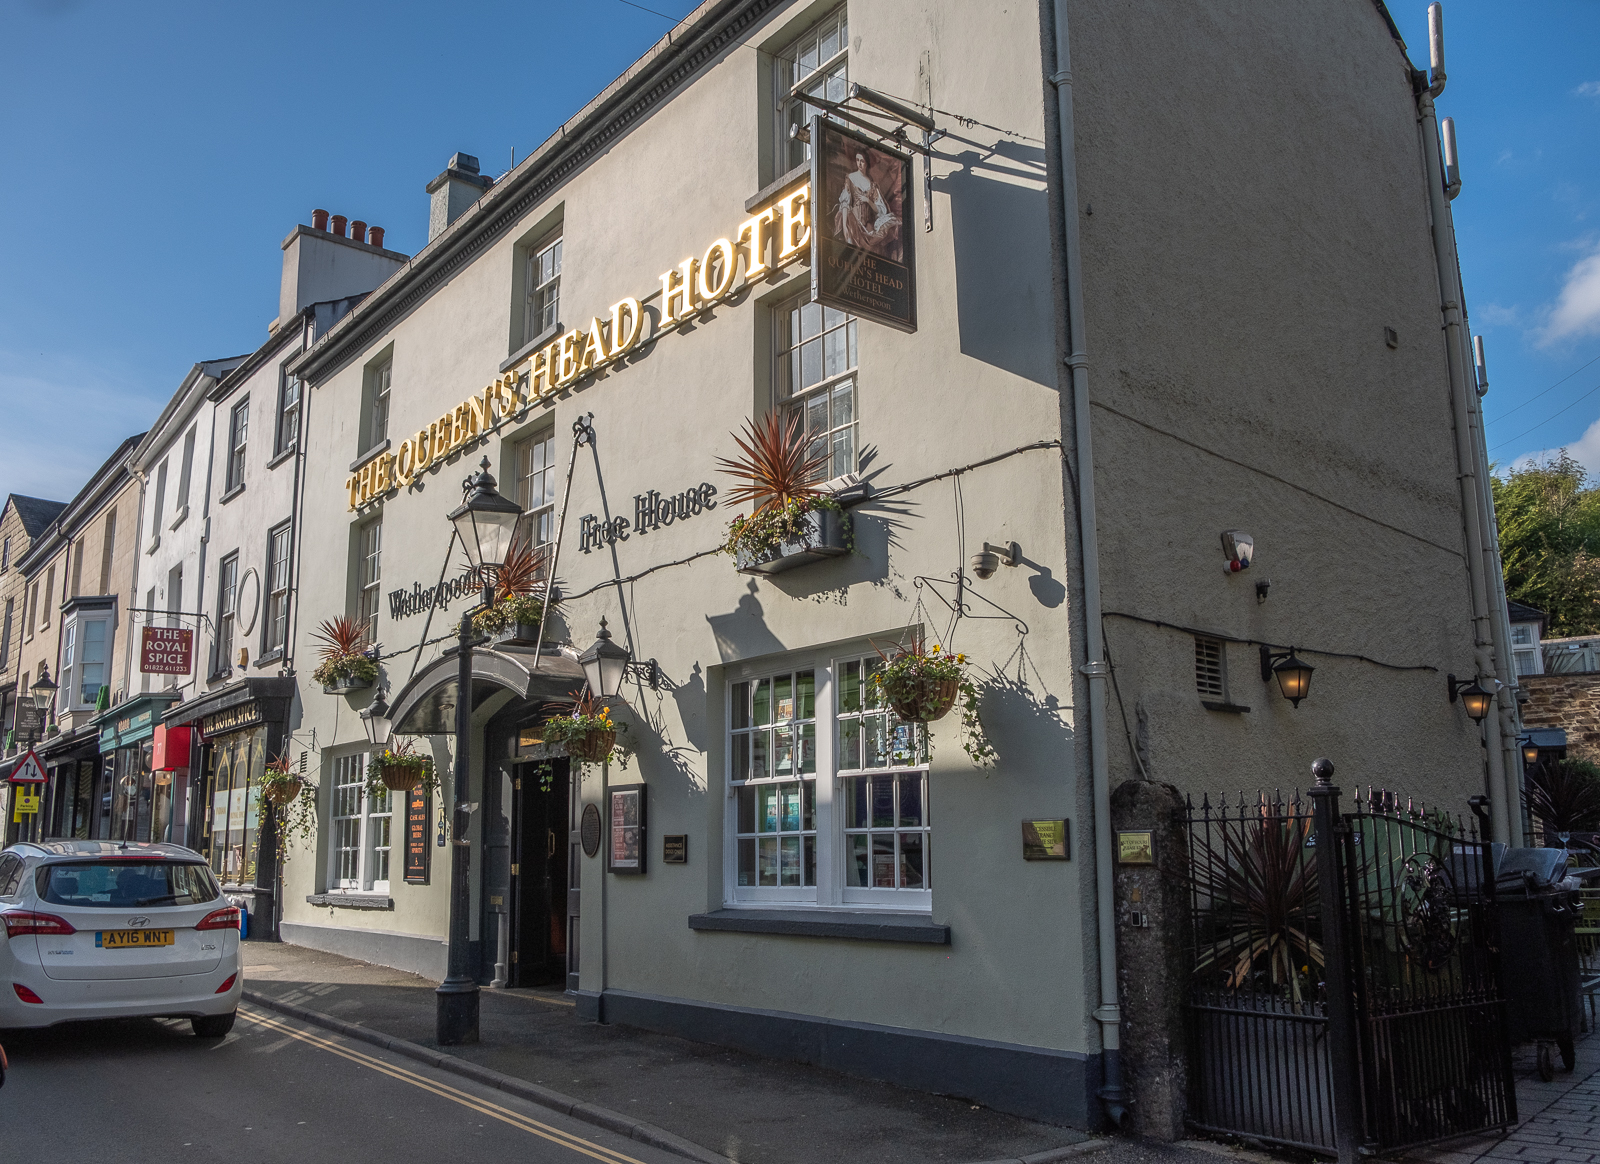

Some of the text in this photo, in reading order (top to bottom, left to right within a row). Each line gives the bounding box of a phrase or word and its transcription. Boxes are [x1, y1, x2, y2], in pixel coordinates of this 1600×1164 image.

[849, 276, 884, 295] HOTEL
[875, 272, 903, 290] HEAD
[843, 286, 892, 311] Wetherspoon
[346, 185, 811, 512] THE QUEEN'S HEAD HOTE
[578, 482, 715, 553] Free House
[155, 628, 180, 640] THE
[146, 640, 189, 652] ROYAL
[148, 652, 184, 664] SPICE
[202, 702, 257, 734] THE ROYAL SPICE
[107, 931, 170, 945] AY16 WNT
